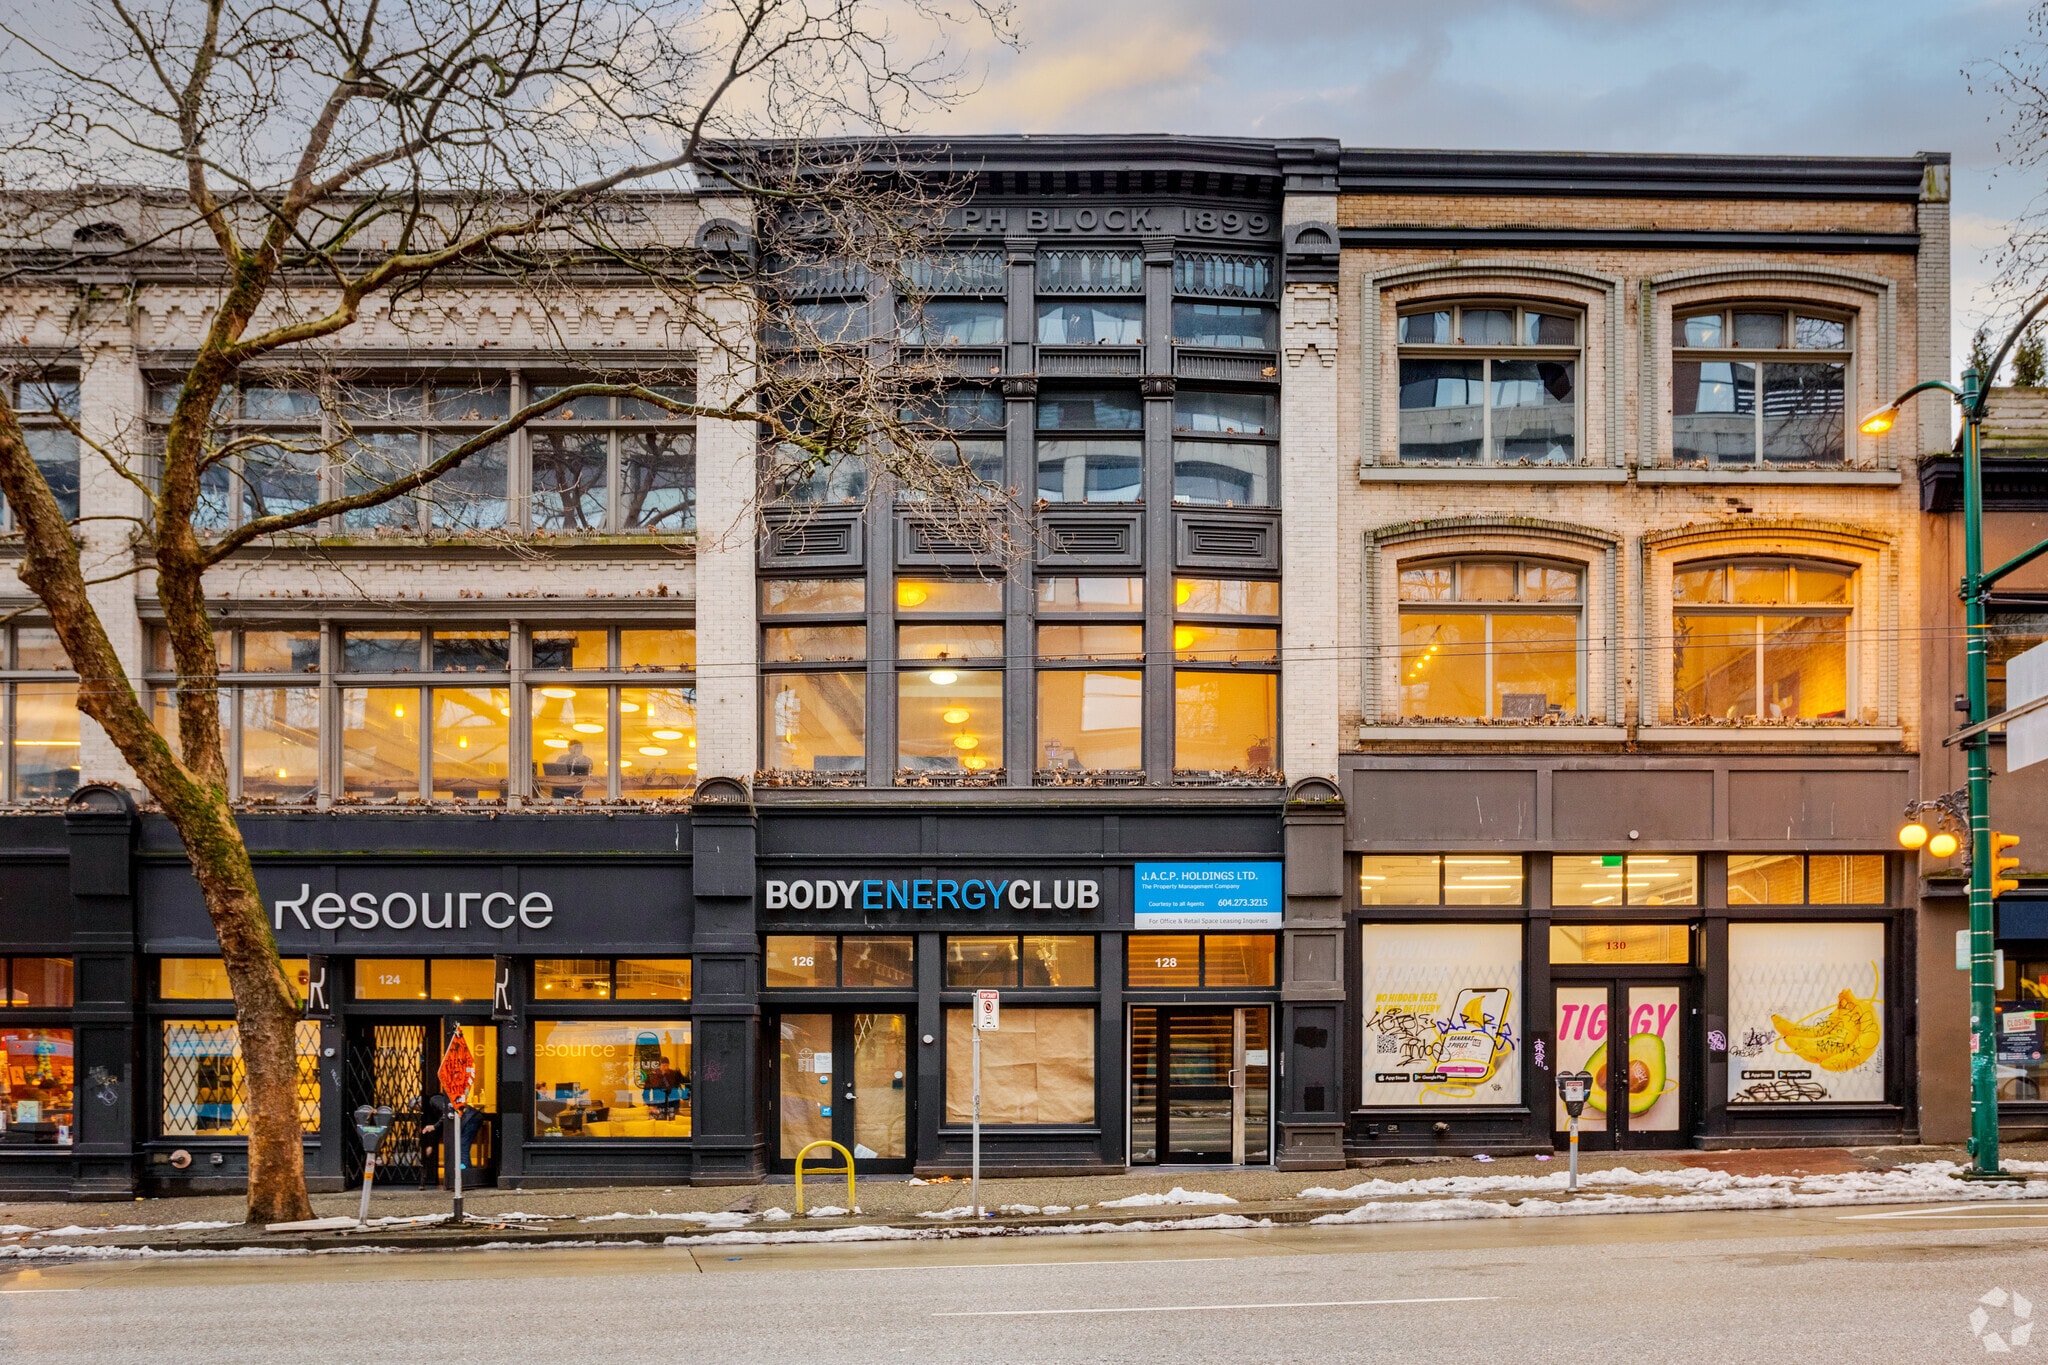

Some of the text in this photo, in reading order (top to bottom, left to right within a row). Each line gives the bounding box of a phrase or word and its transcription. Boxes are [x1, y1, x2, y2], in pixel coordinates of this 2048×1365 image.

[1183, 208, 1270, 234] 1899
[1141, 871, 1259, 881] J.A.C.P. HOLDINGS LTD.
[274, 883, 554, 929] Resource
[1218, 898, 1268, 907] 604.273.3215
[1201, 918, 1219, 926] Space
[1220, 918, 1242, 926] Leasing
[1243, 918, 1268, 926] Inquiries
[1606, 941, 1626, 950] 130
[792, 955, 814, 967] 126
[1155, 957, 1177, 968] 128
[378, 974, 401, 985] 124
[1376, 992, 1438, 1003] NO HIDDEN FEES
[1403, 1004, 1441, 1013] DELIVERY
